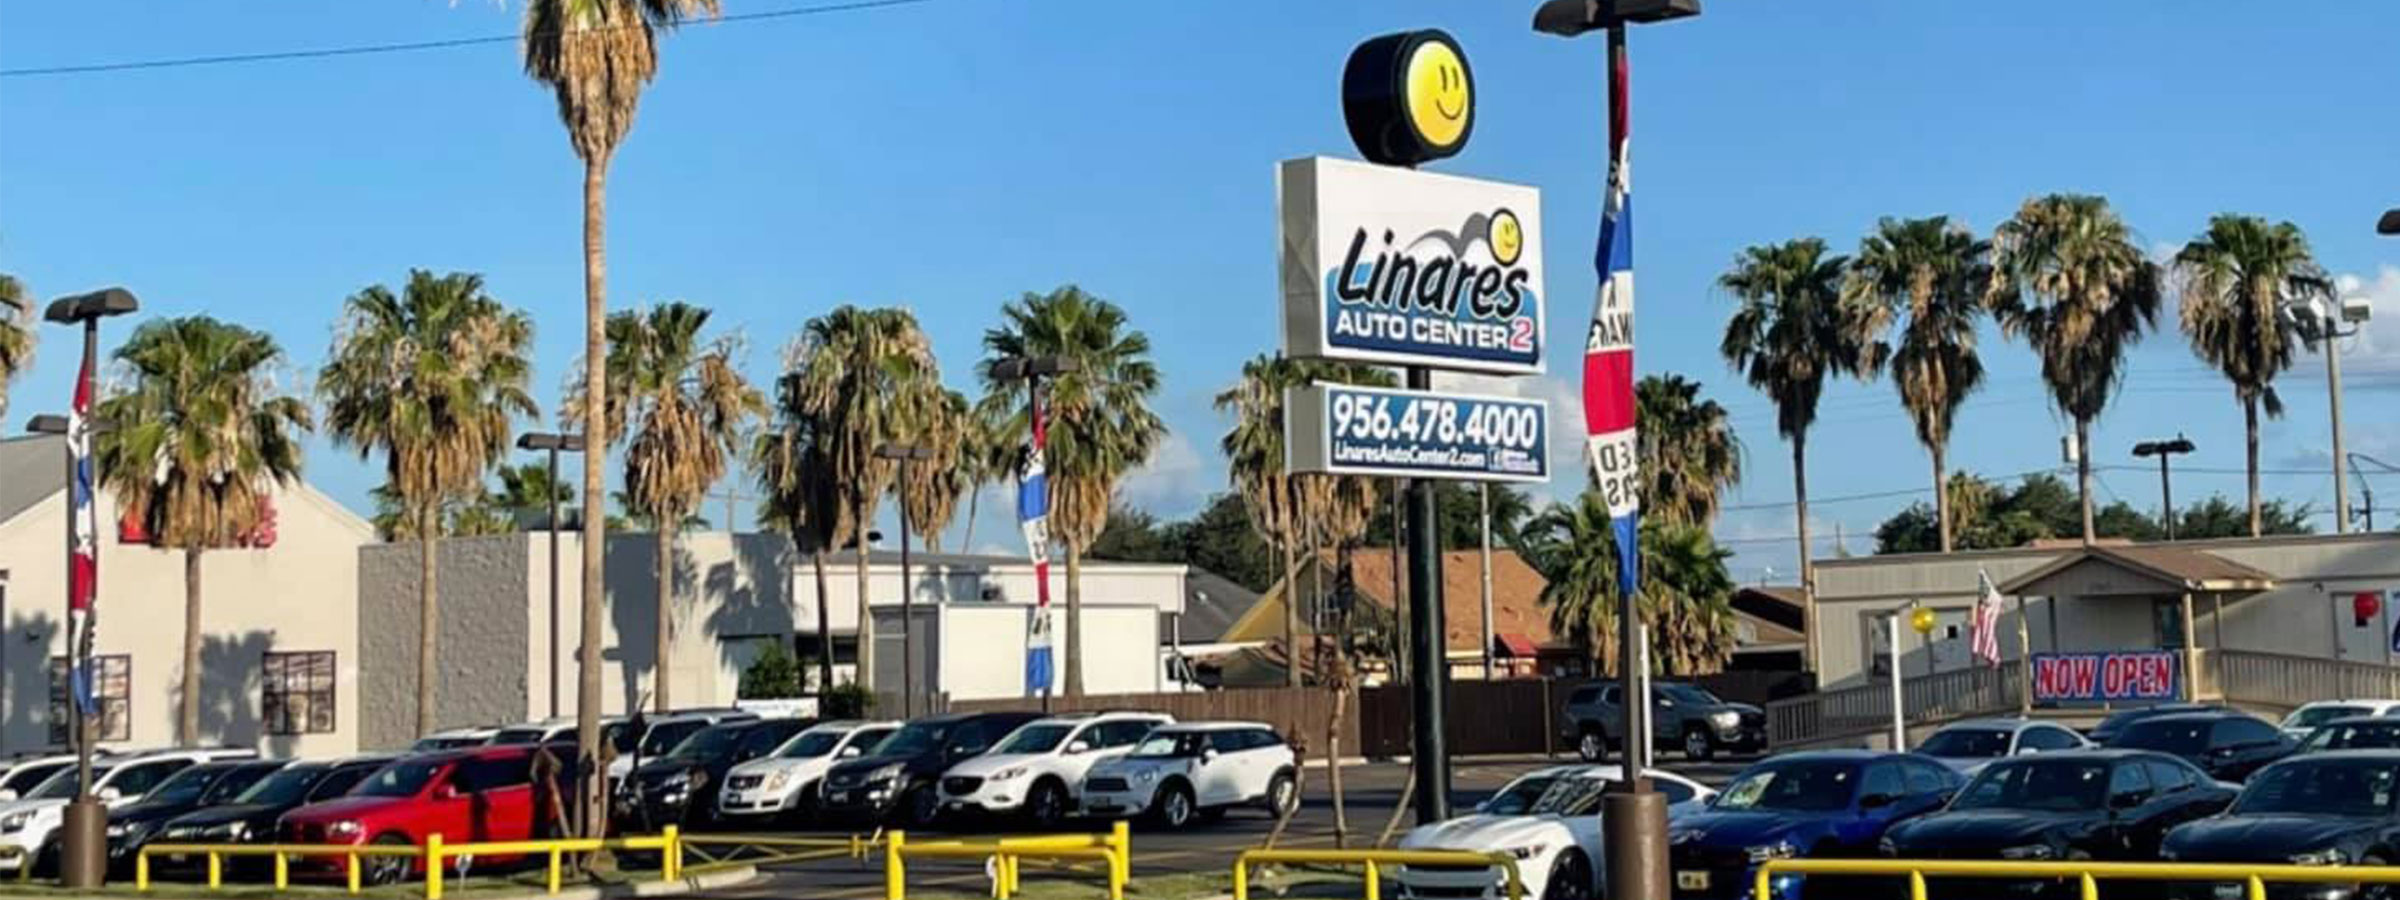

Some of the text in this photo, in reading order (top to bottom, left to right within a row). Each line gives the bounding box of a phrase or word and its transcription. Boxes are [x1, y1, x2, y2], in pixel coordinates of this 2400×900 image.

[1337, 227, 1527, 318] Linares
[1335, 310, 1534, 351] AUTO CENTER 2
[1333, 394, 1538, 448] 956.478.4000
[1335, 441, 1486, 467] LinaresAutoCenter2.com
[2037, 653, 2173, 698] NOW OPEN
